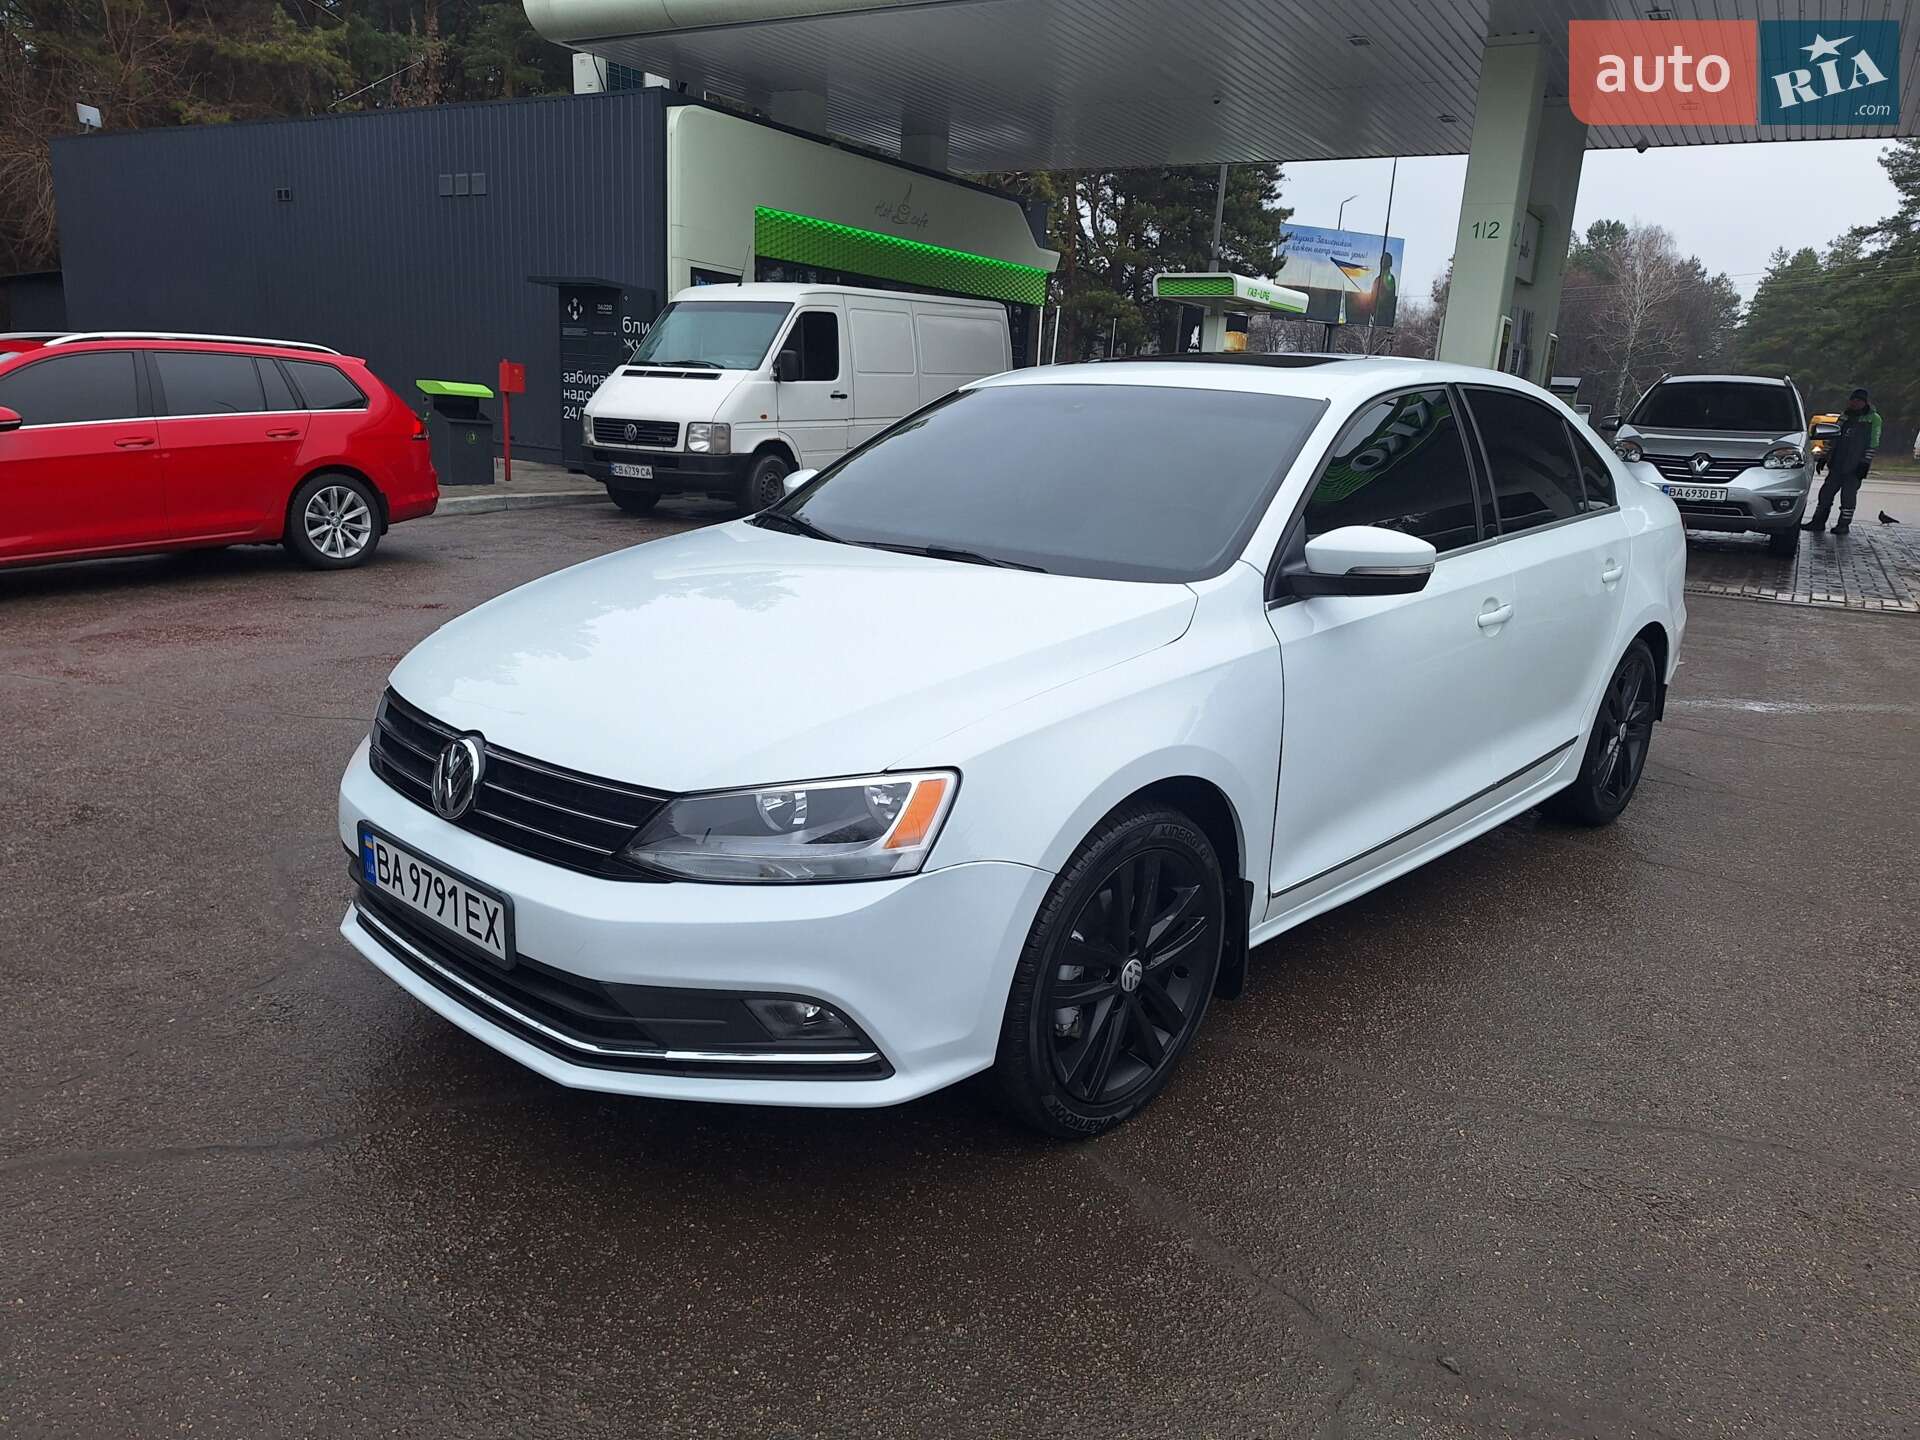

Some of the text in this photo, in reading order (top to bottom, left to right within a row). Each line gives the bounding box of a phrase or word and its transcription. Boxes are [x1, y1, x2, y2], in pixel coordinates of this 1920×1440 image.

[622, 316, 650, 335] бли
[562, 370, 611, 388] забира
[563, 388, 596, 403] надс
[1669, 487, 1726, 500] BA 6930 BT
[376, 842, 501, 951] BA 9791 EX
